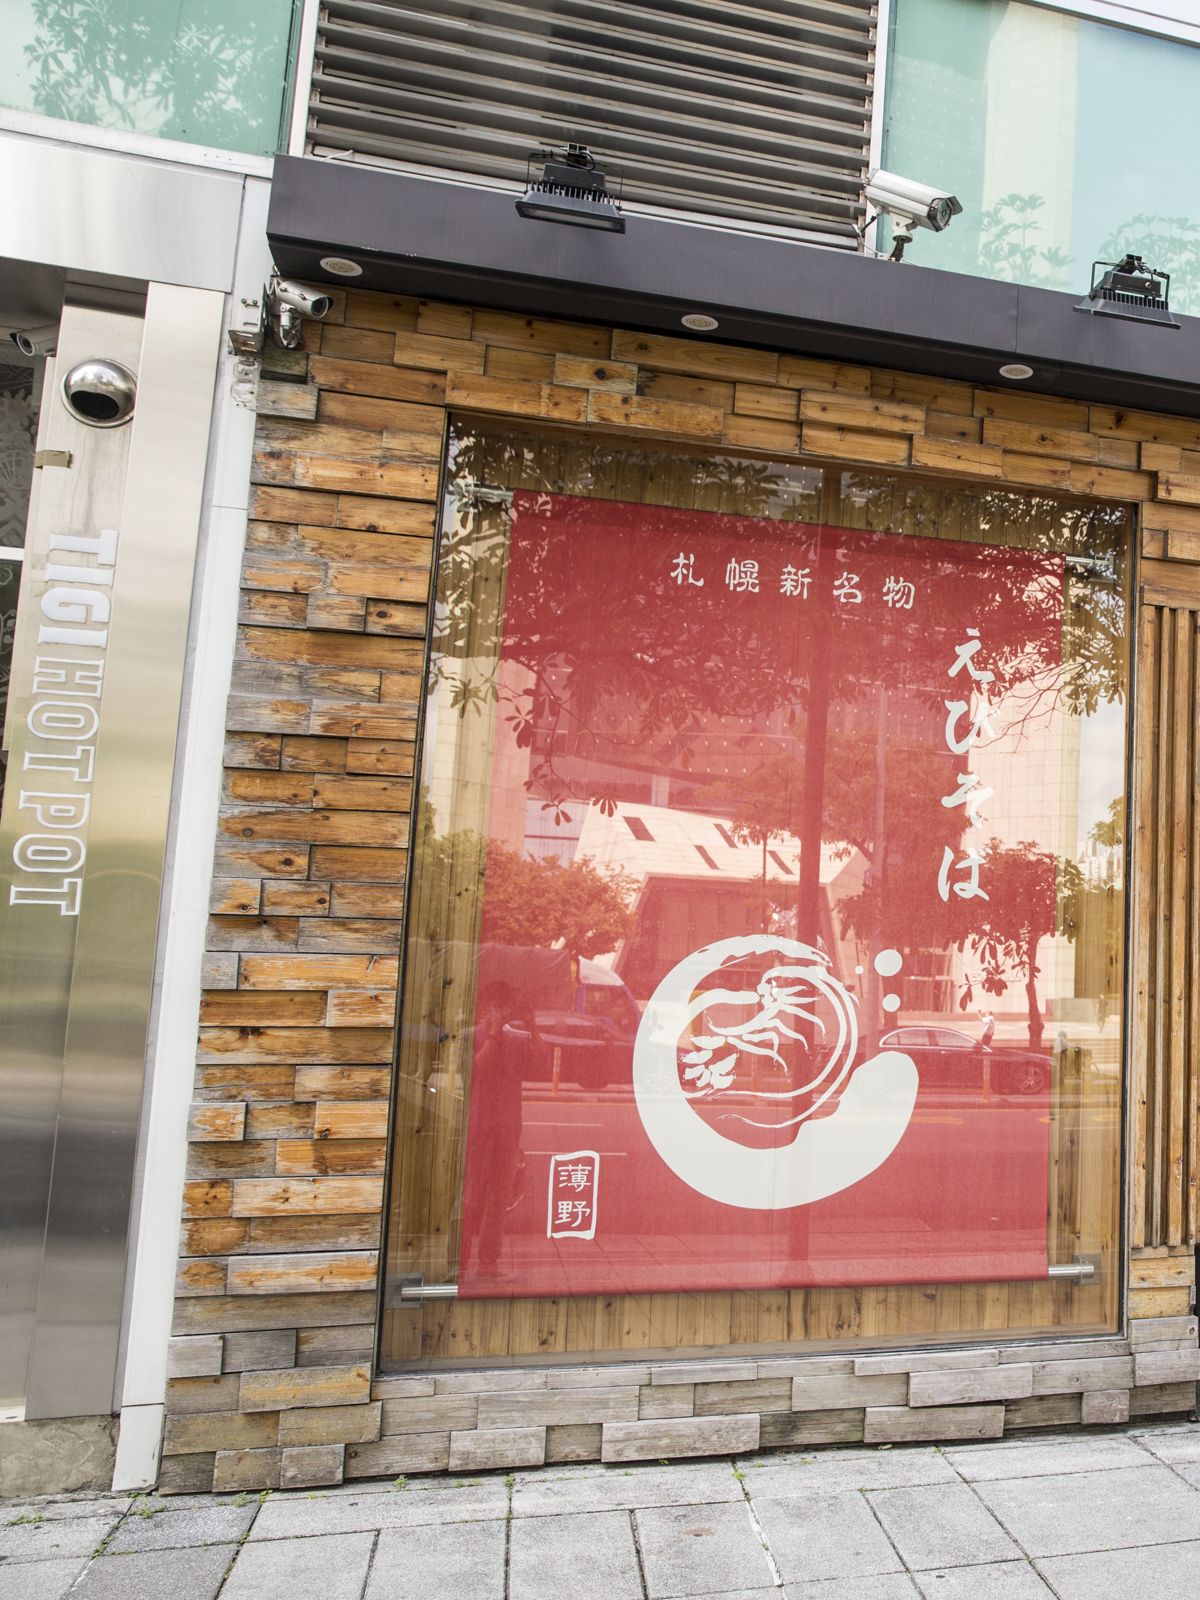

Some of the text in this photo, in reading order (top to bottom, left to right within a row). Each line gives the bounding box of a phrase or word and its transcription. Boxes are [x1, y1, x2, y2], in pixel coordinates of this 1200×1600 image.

[670, 552, 917, 610] 札幌新名物
[23, 655, 105, 783] HOT
[938, 628, 998, 902] えびそば
[9, 790, 91, 917] POT
[555, 1163, 592, 1227] 薄野
